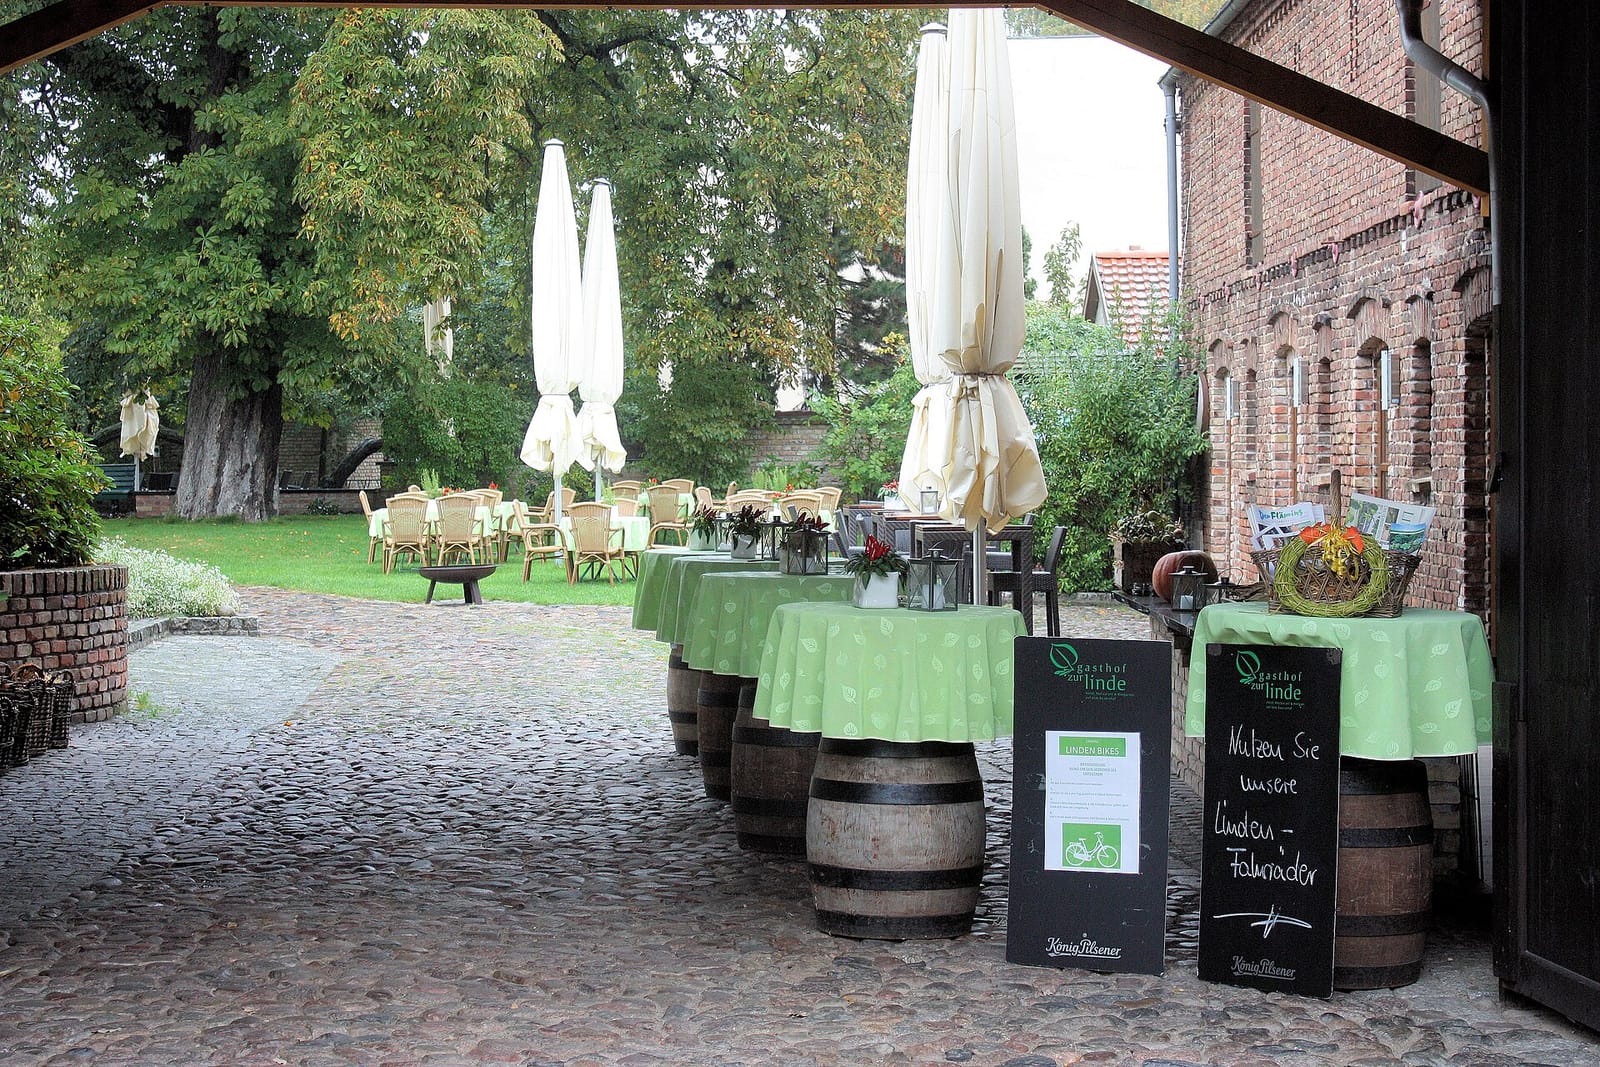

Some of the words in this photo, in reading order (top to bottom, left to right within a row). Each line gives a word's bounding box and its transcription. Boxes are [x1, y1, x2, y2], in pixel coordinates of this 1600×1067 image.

[1077, 663, 1127, 674] gasthof
[1067, 674, 1084, 682] zur
[1084, 674, 1126, 691] linde
[1258, 671, 1303, 682] gasthof
[1250, 682, 1265, 690] zur
[1265, 682, 1302, 701] linde
[1065, 746, 1096, 755] LINDEN
[1096, 746, 1120, 756] BIKES
[1292, 731, 1320, 760] Sie
